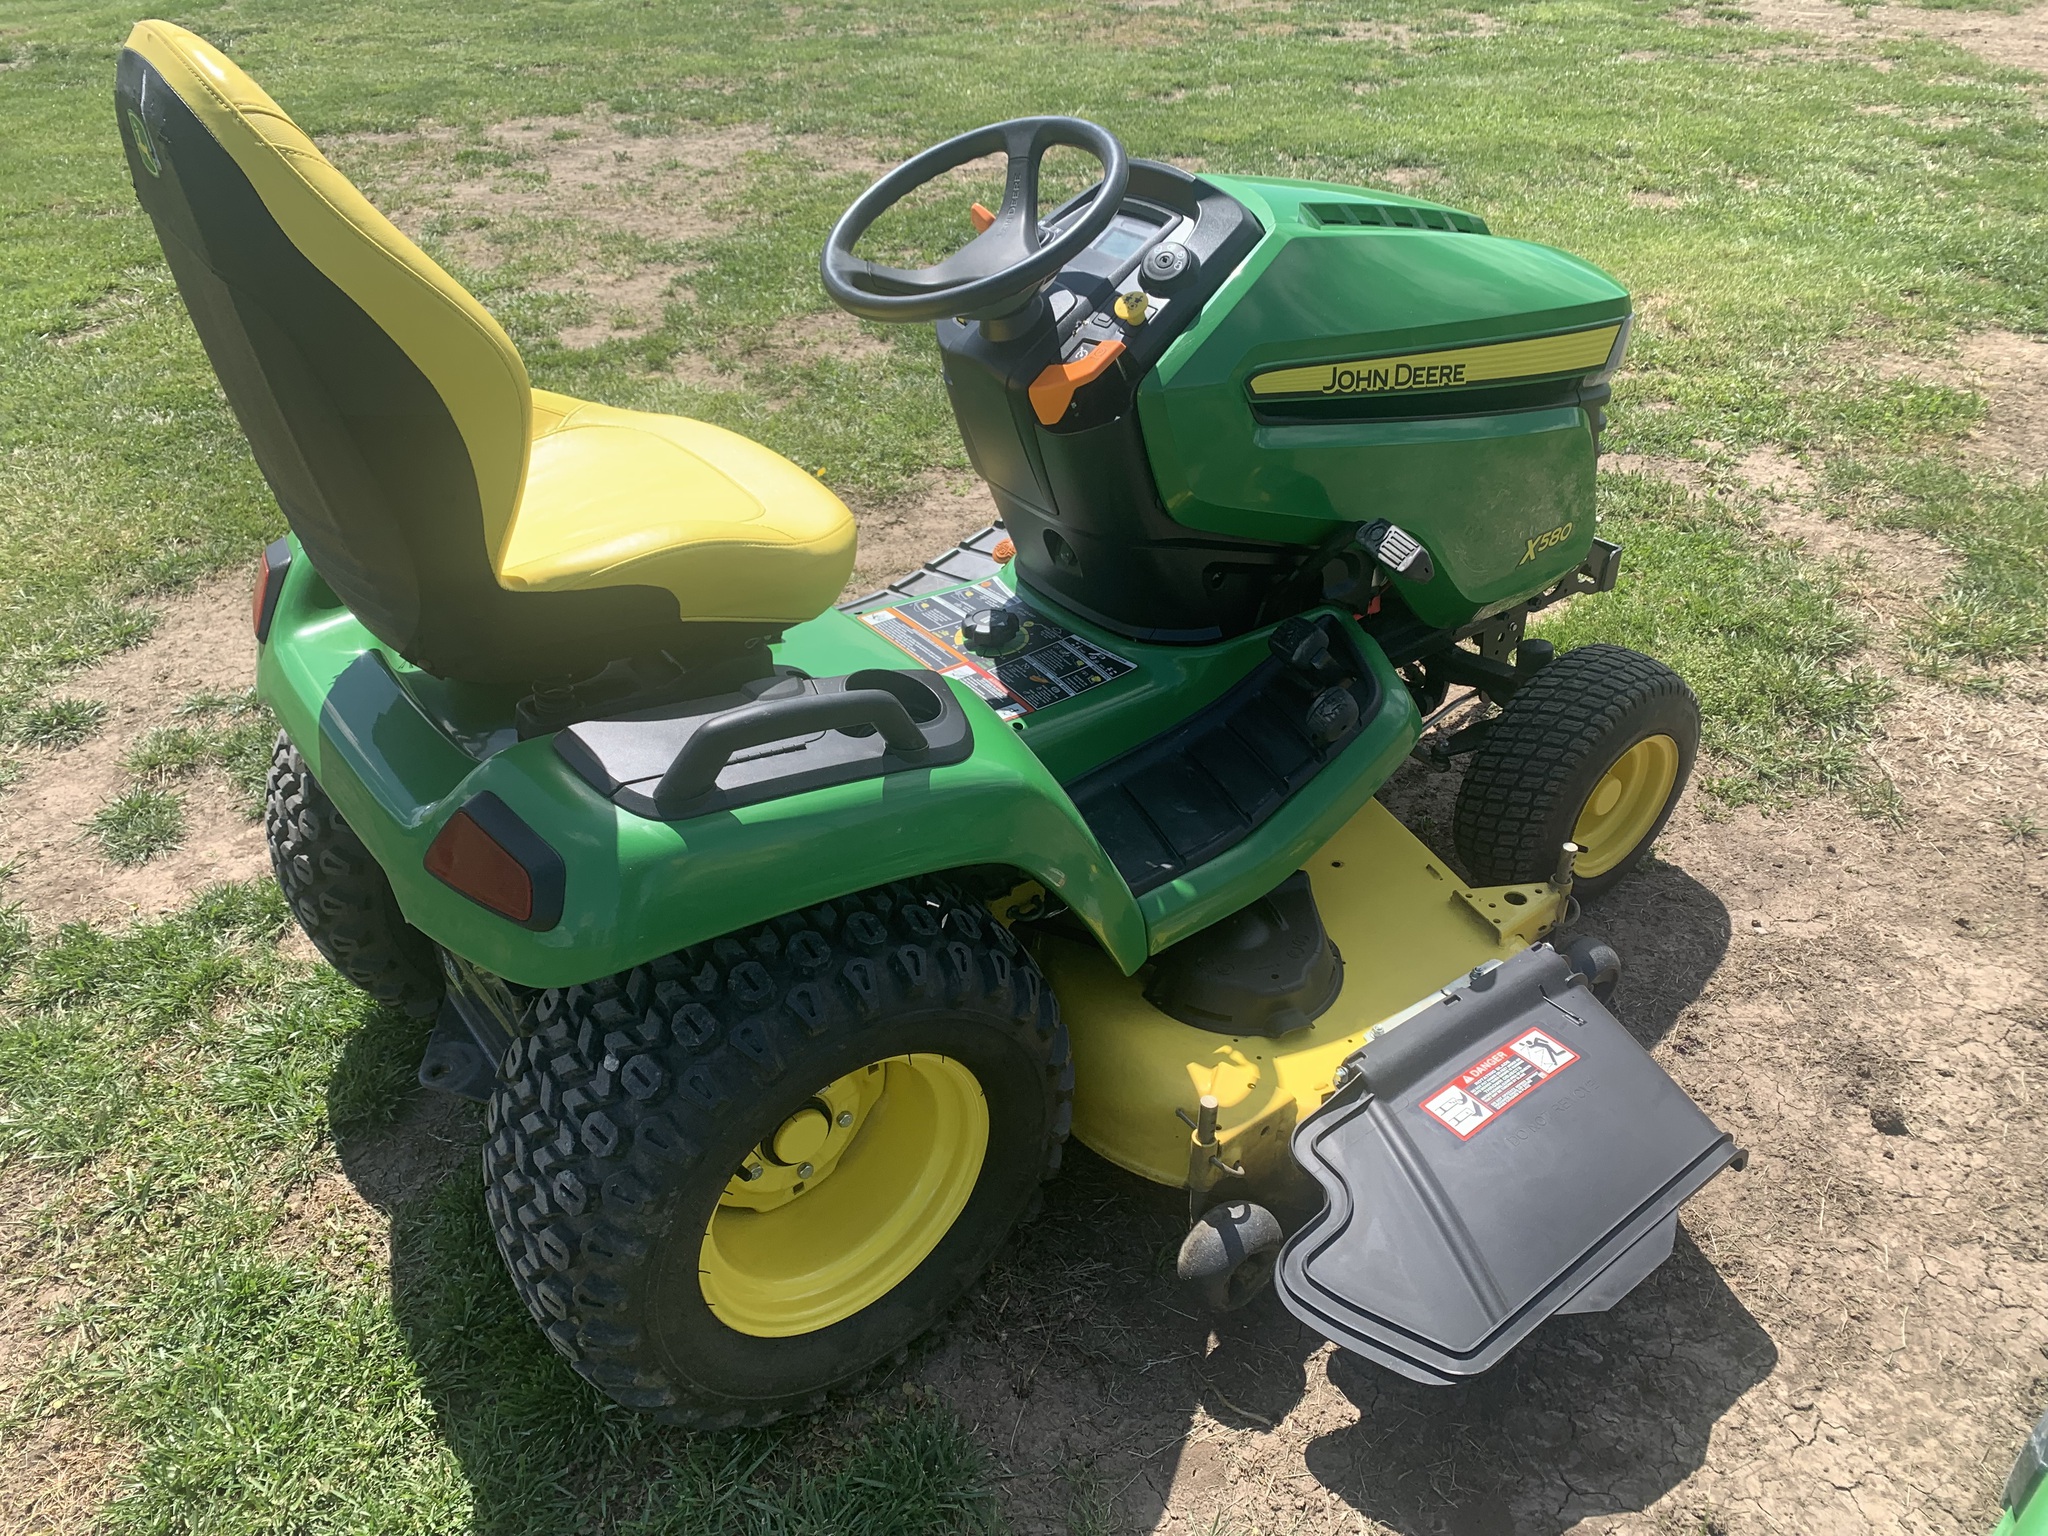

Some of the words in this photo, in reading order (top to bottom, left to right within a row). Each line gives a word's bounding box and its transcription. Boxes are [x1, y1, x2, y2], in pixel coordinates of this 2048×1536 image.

[1322, 366, 1389, 392] JOHN
[1394, 363, 1466, 388] DEERE
[1518, 522, 1573, 566] X580
[1469, 1051, 1508, 1077] DANGER
[1506, 1129, 1529, 1147] DO
